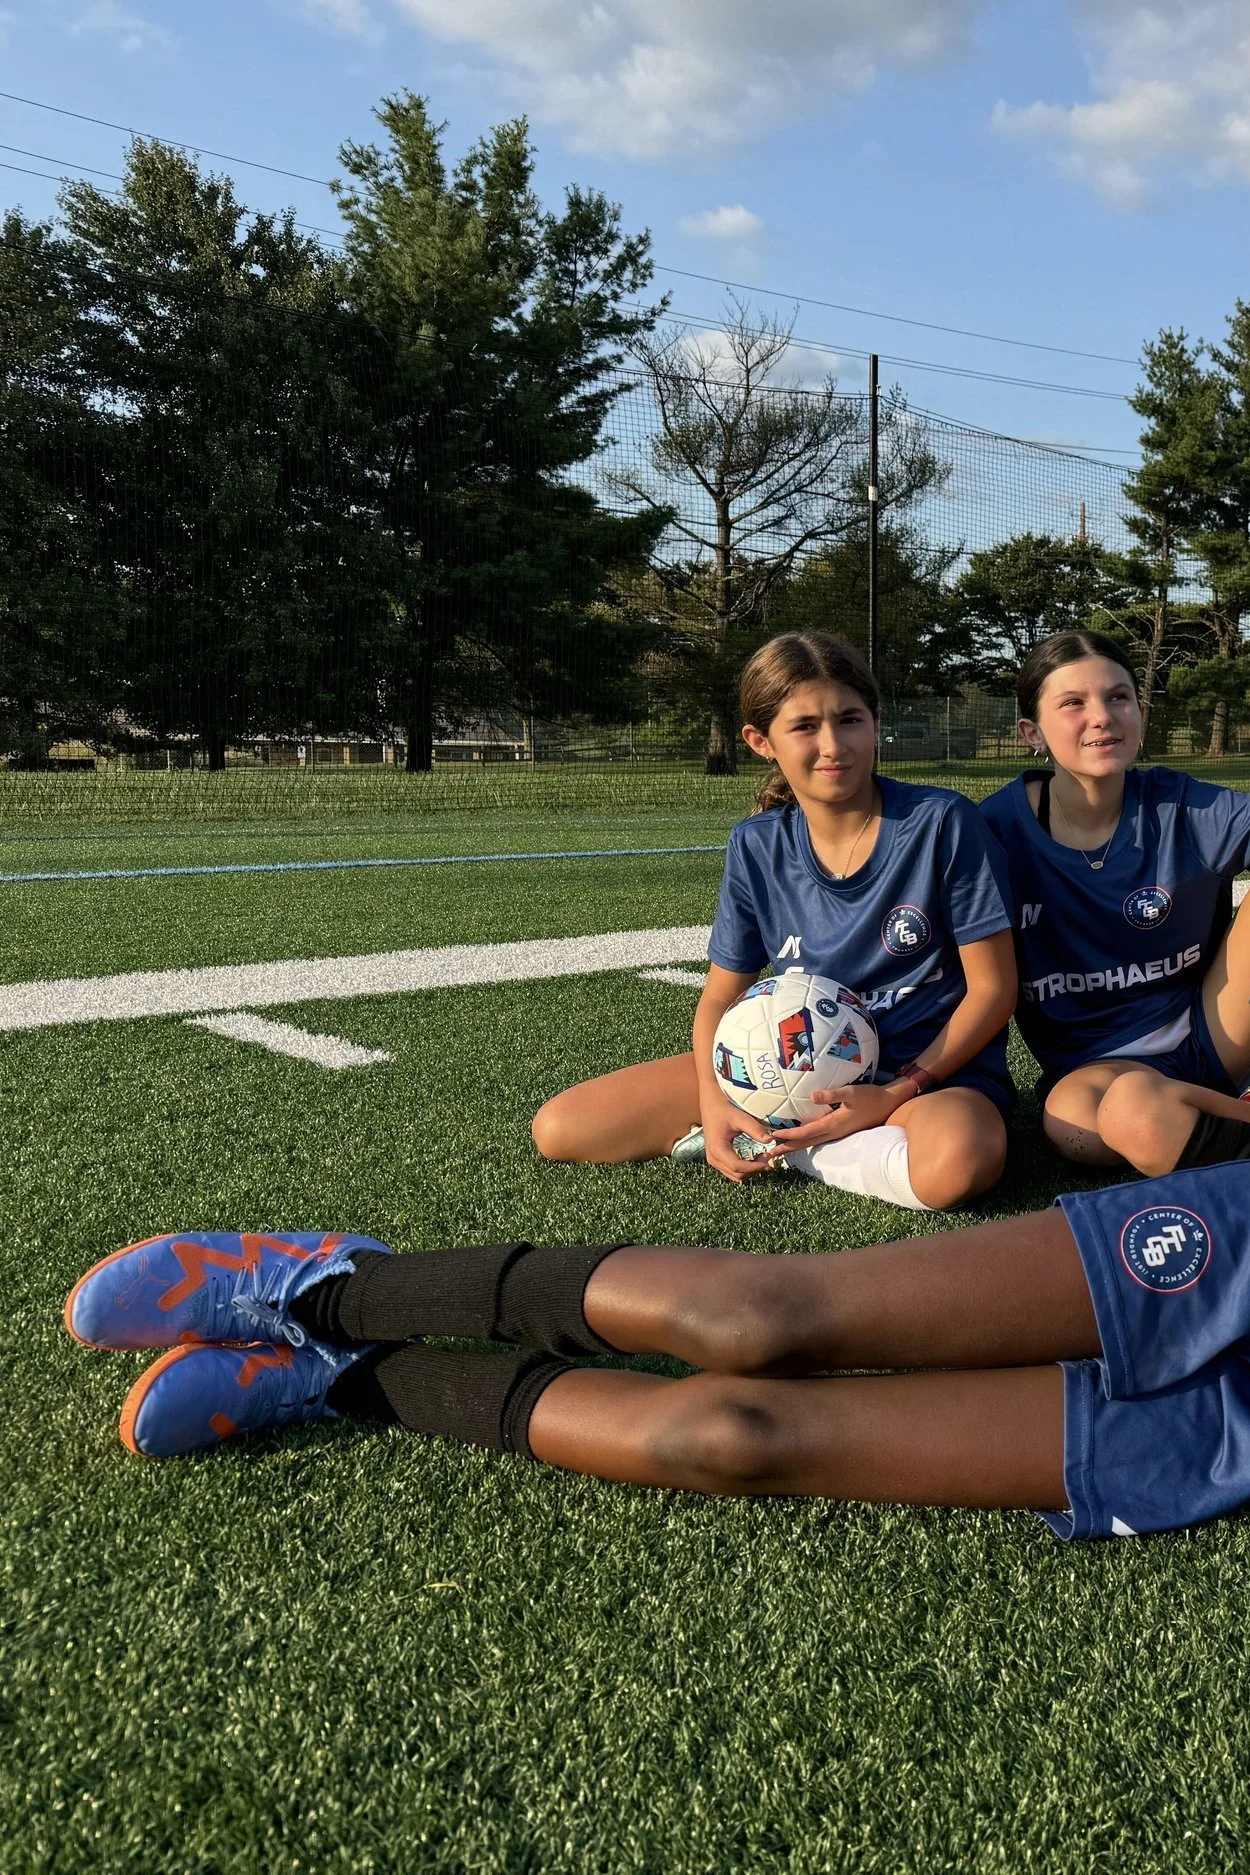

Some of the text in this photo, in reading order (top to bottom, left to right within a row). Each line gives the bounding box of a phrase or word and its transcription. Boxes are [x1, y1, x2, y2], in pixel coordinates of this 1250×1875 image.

[756, 1052, 786, 1090] ROSA
[1129, 1224, 1140, 1260] FOUNDED
[1147, 1212, 1203, 1283] CENTER OF EXCELLENCE
